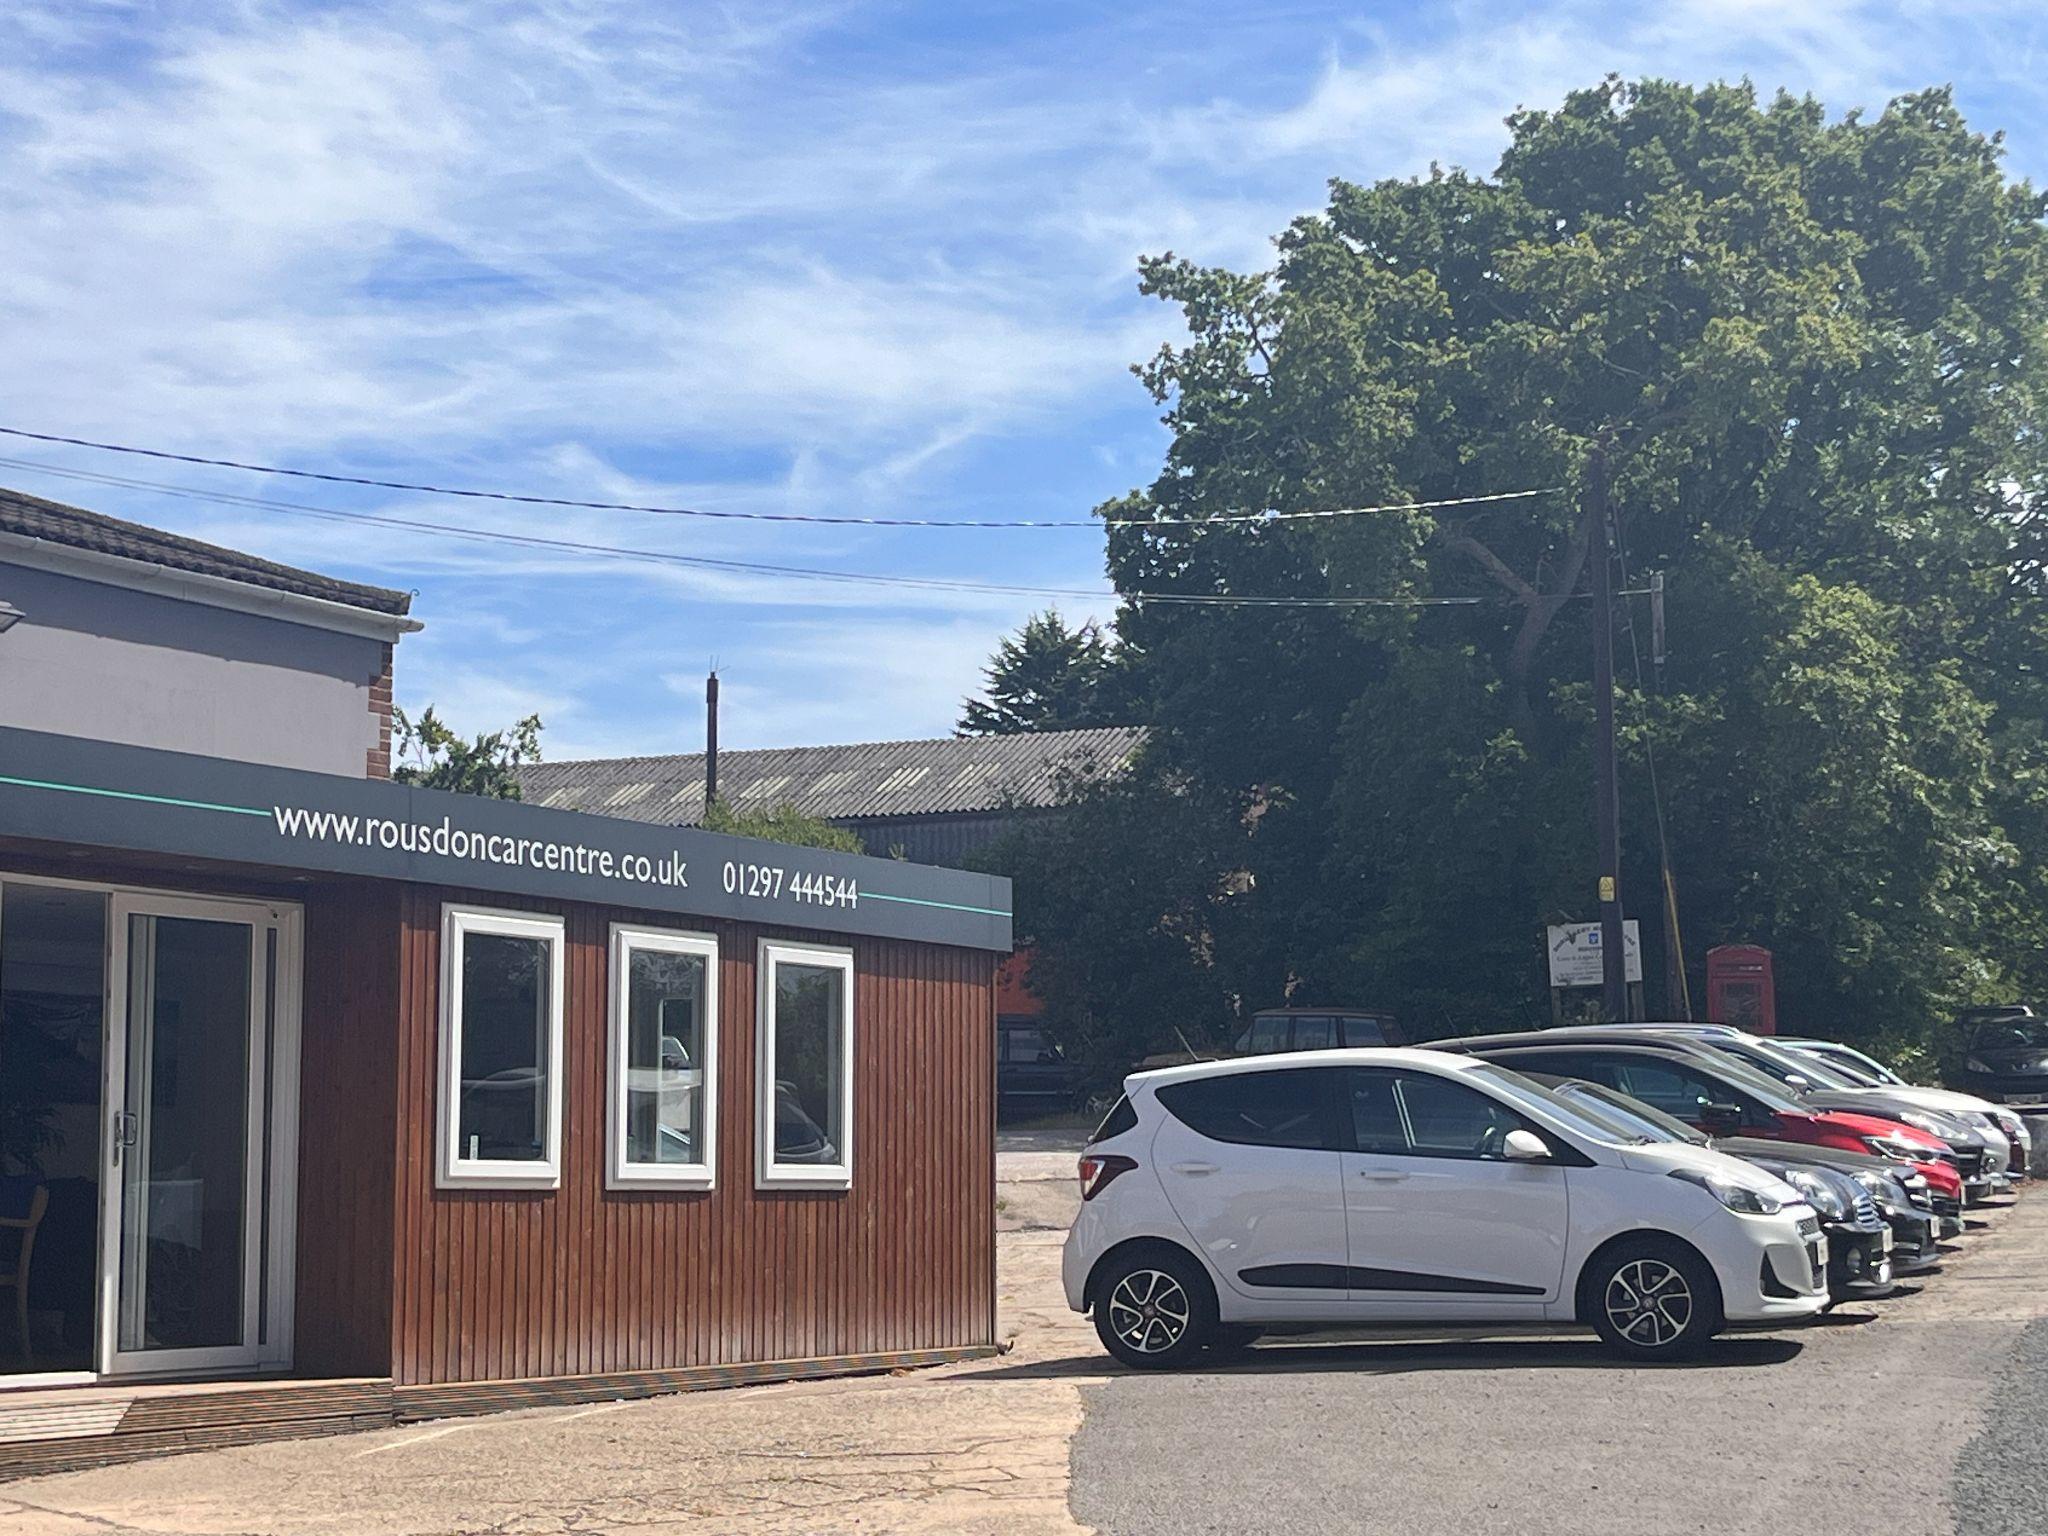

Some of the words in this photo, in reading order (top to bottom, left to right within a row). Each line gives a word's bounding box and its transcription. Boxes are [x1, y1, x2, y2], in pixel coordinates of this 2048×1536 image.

[273, 805, 688, 888] www.rousdoncarcentre.co.uk
[723, 861, 783, 899] 01297
[788, 871, 859, 909] 444544
